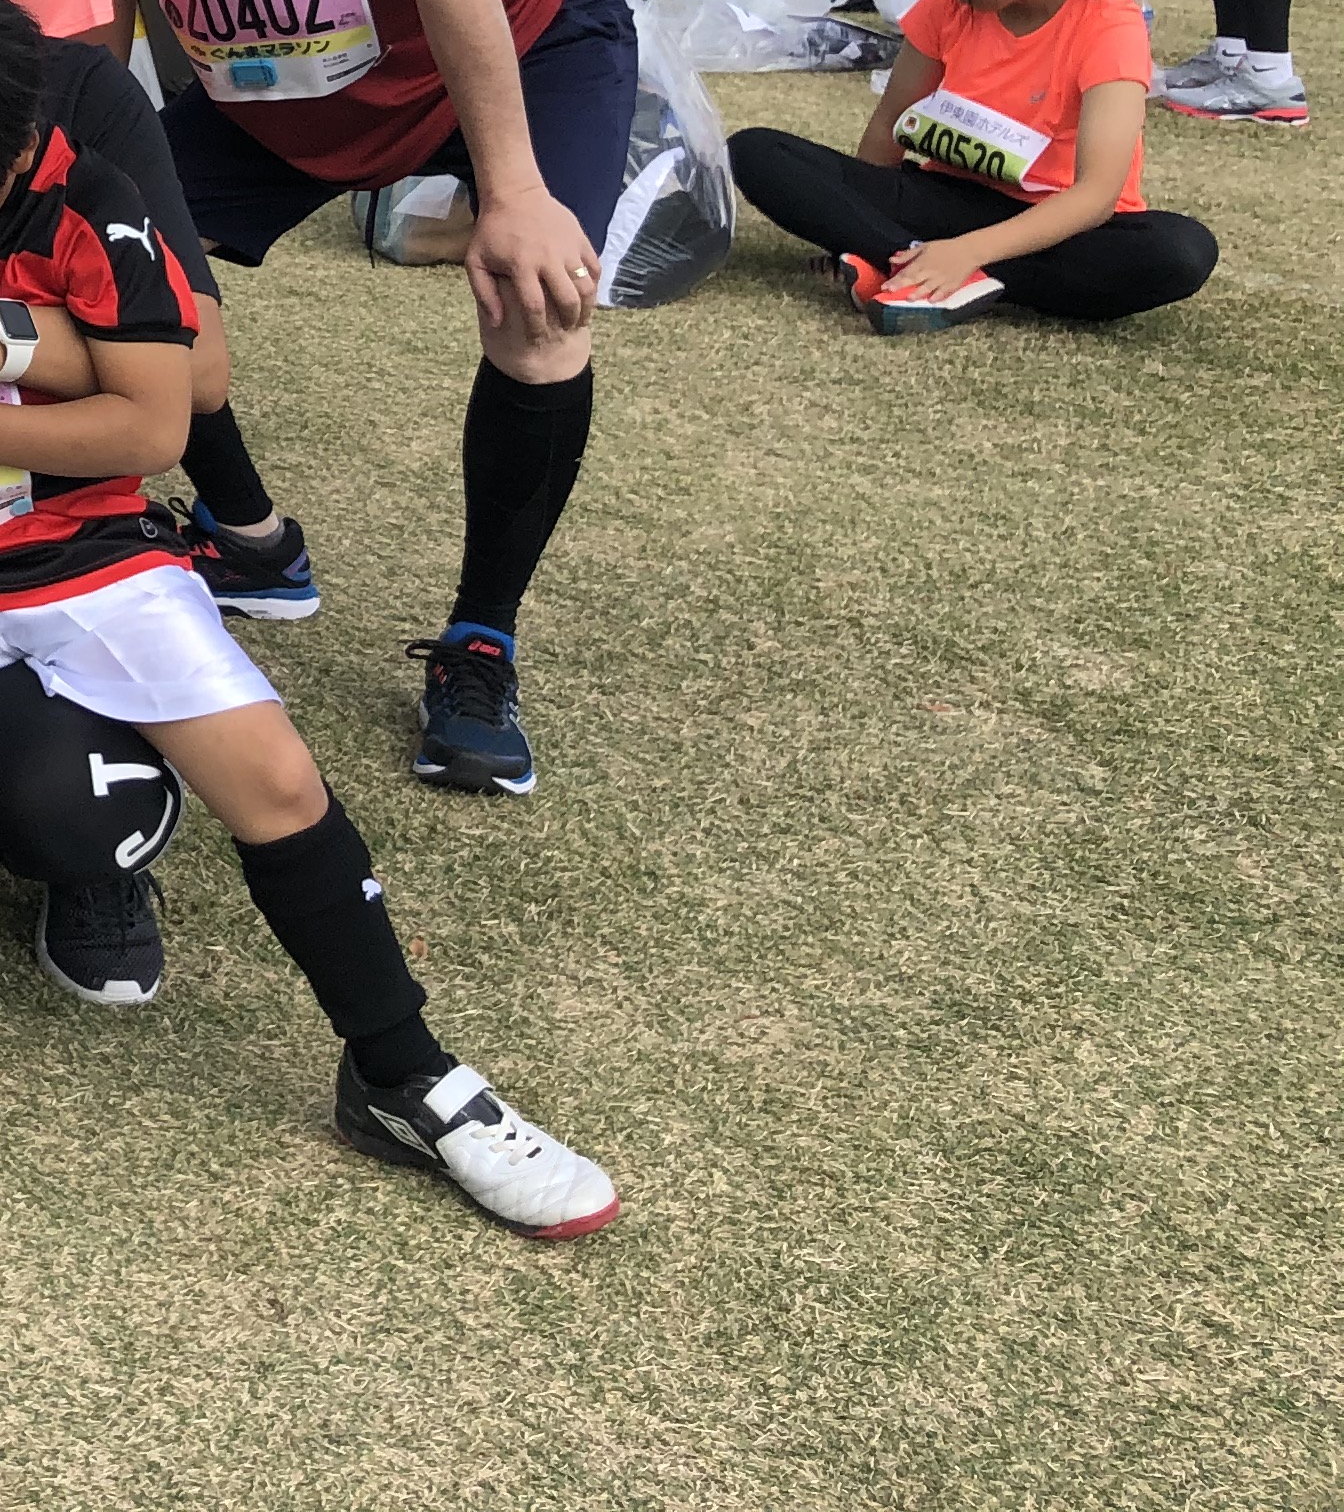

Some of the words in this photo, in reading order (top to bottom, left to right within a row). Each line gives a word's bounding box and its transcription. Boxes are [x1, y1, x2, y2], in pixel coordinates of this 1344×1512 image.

[210, 40, 330, 60] ぐんまマラソン
[939, 99, 1030, 147] 伊東園ホテルズ
